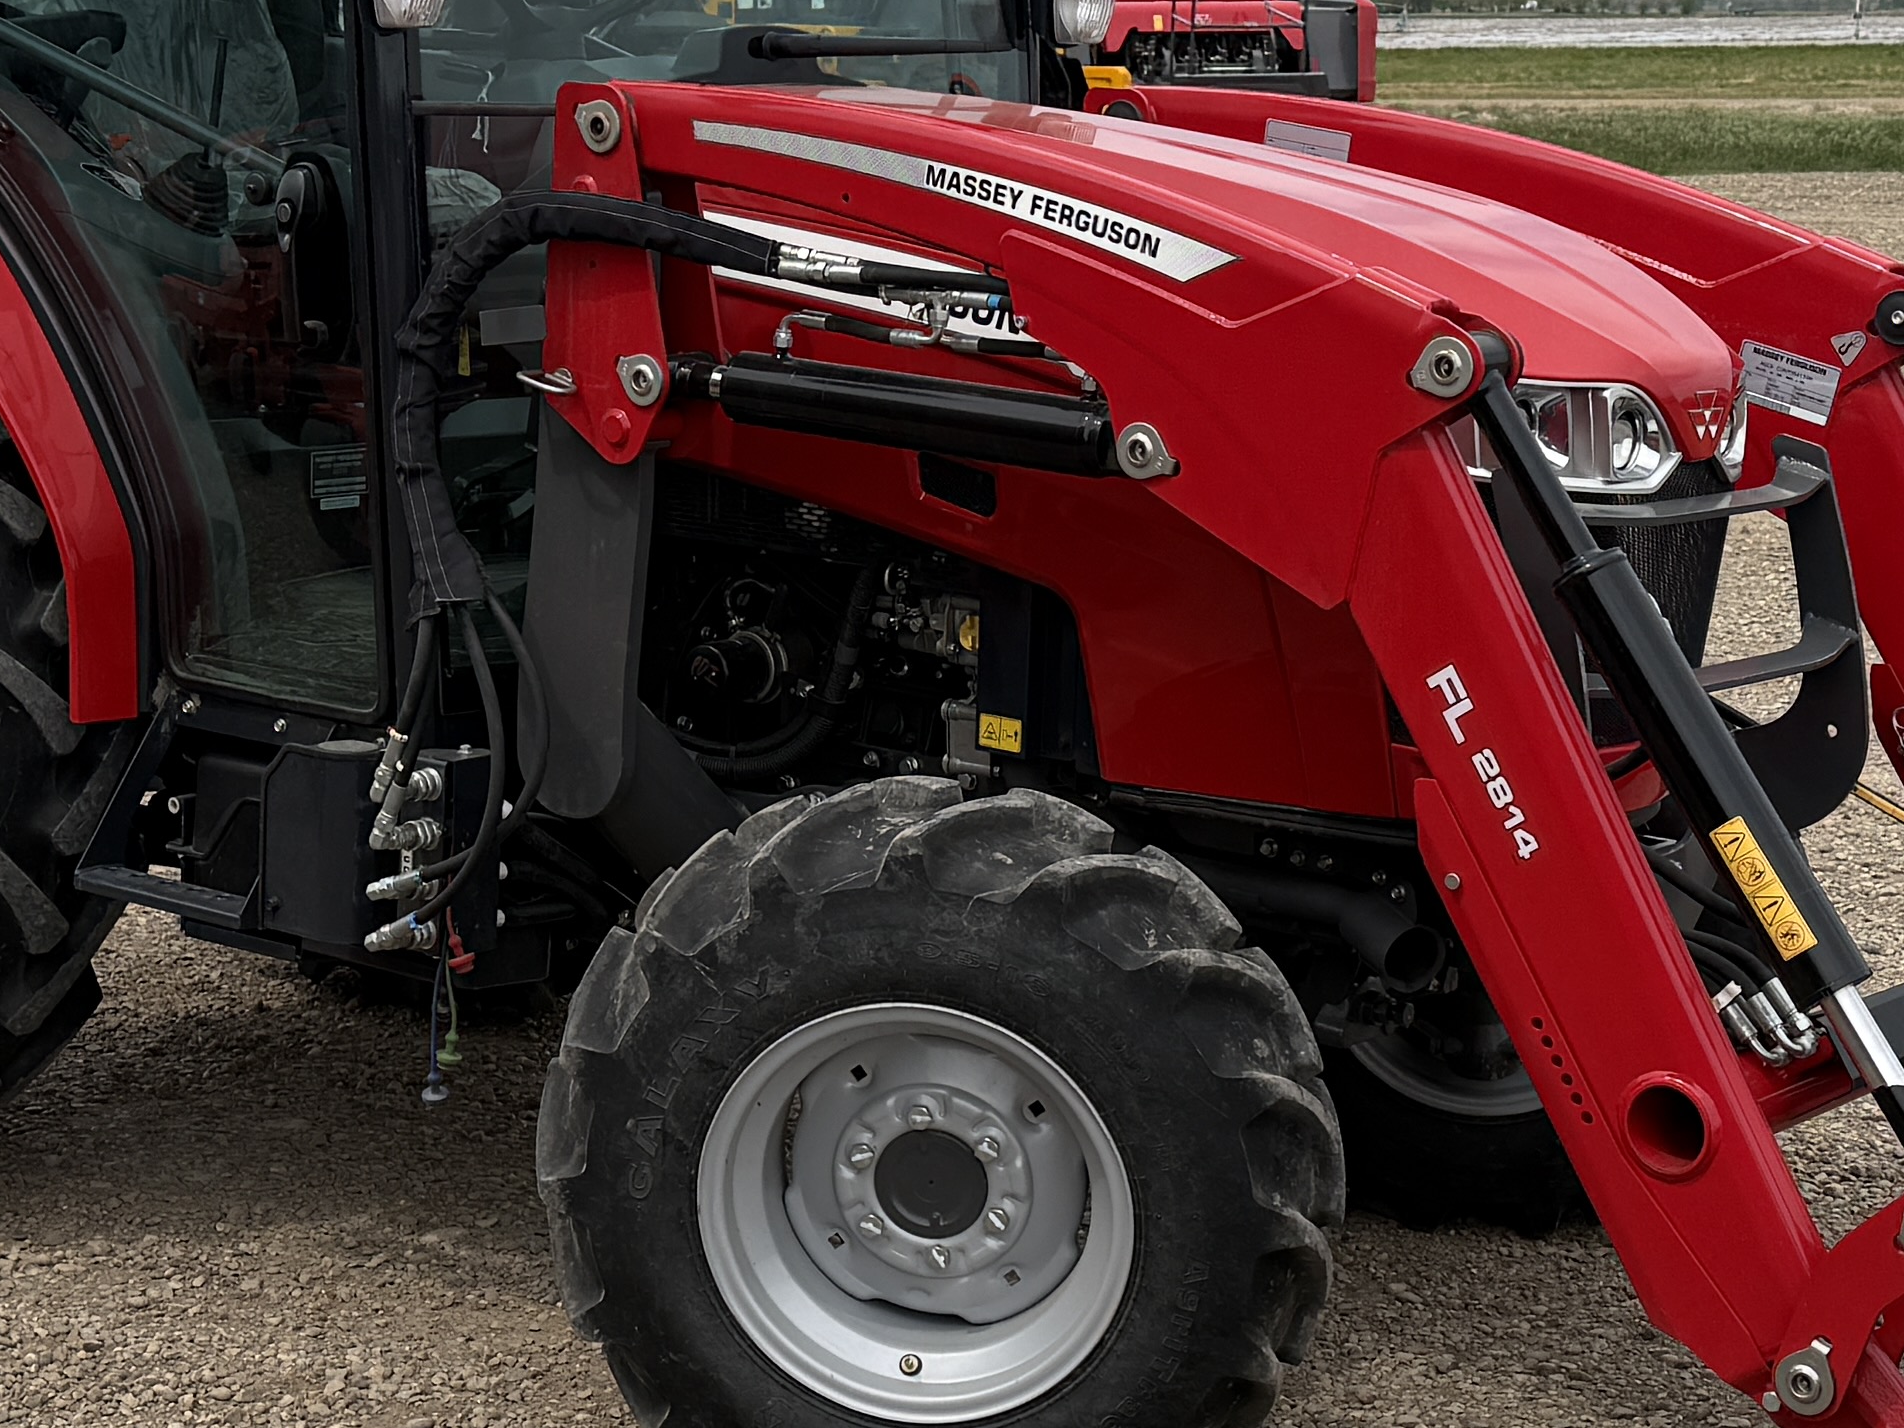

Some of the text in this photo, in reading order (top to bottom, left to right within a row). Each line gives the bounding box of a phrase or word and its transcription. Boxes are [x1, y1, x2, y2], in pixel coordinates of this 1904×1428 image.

[925, 164, 1162, 259] MASSEY FERGUSON
[1426, 664, 1540, 860] FL 2814
